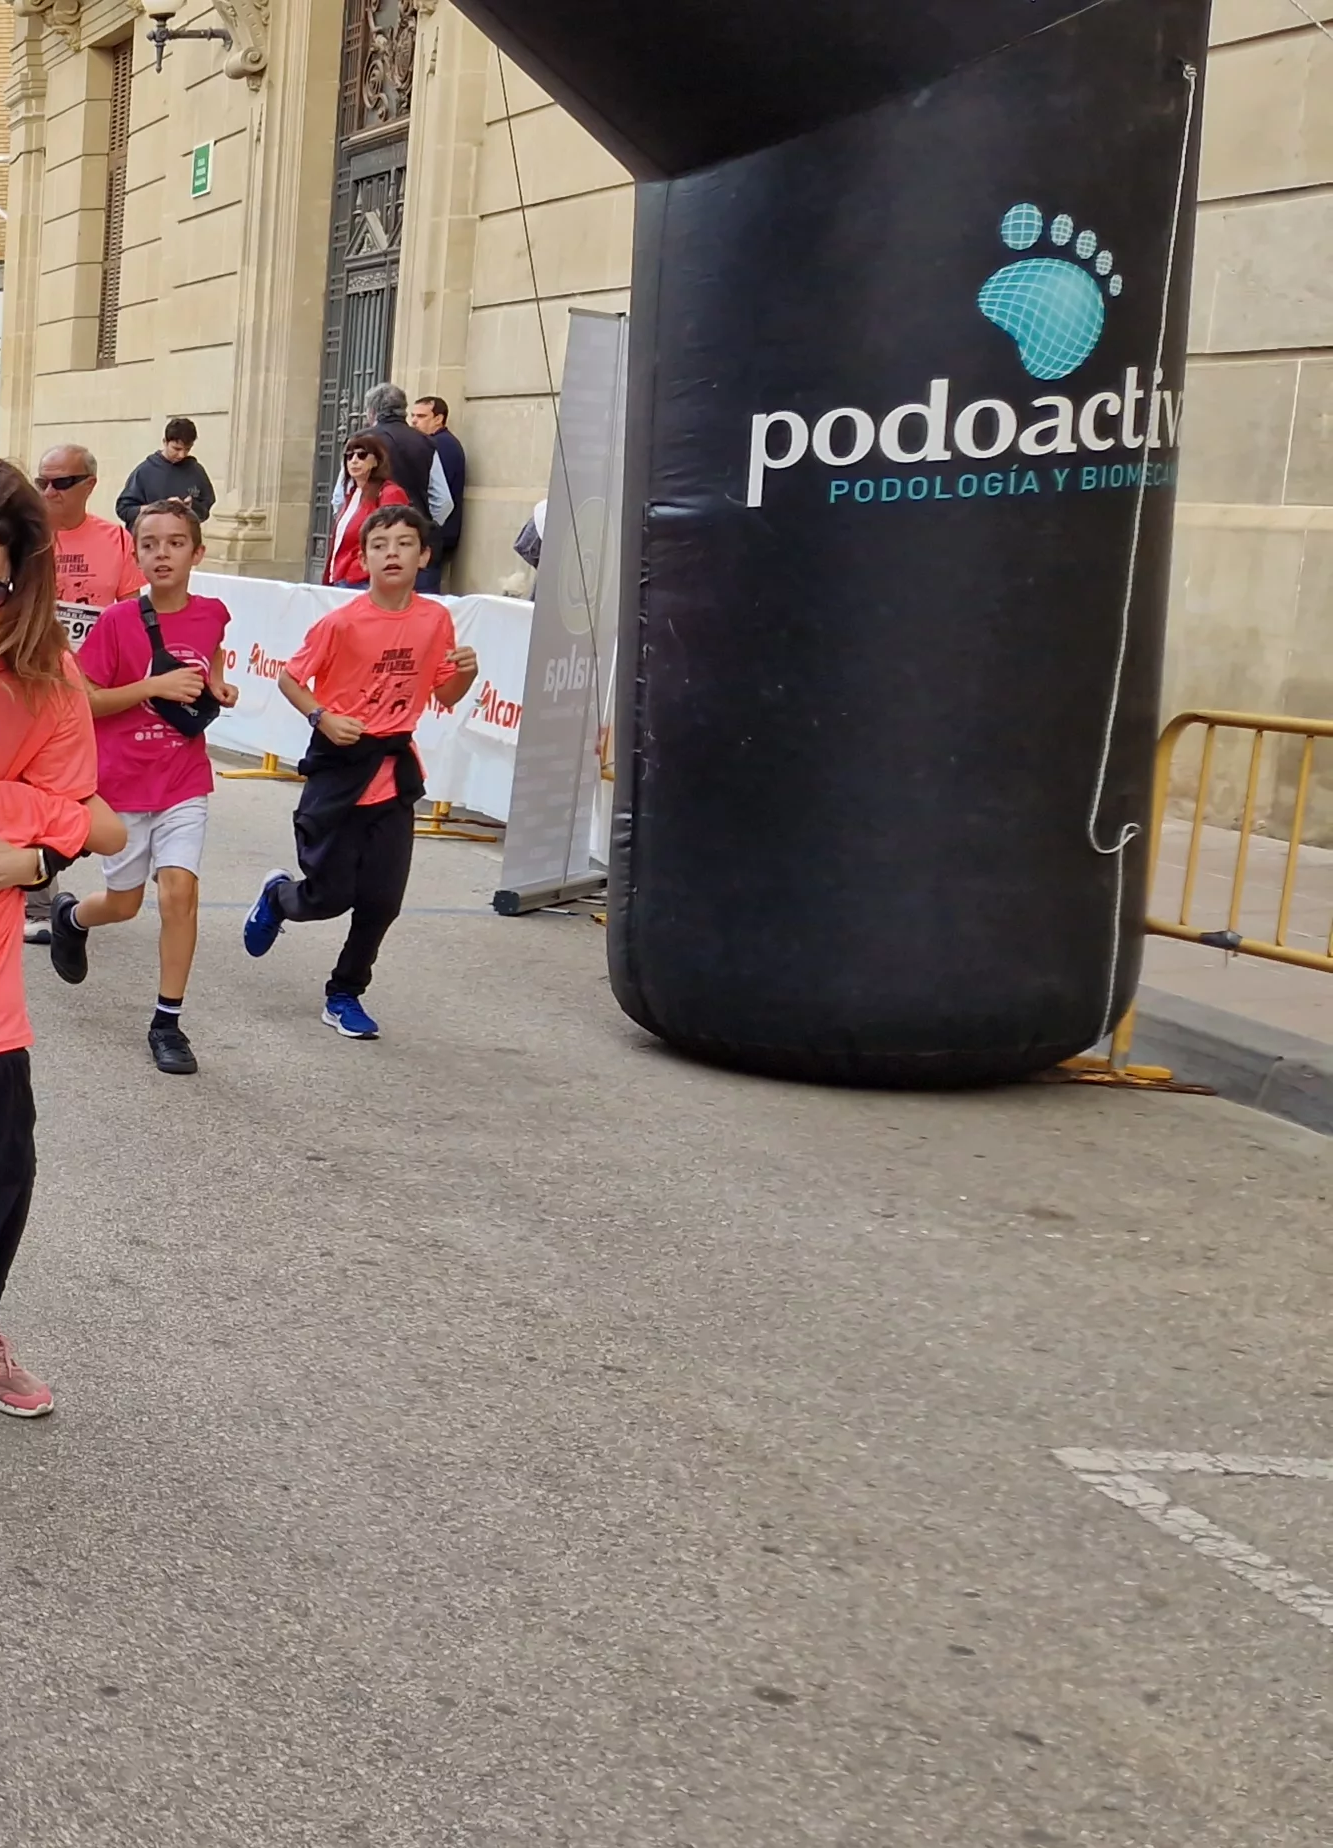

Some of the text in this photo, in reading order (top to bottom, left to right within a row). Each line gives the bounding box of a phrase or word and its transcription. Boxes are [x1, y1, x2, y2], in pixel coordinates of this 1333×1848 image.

[746, 366, 1183, 508] podoactiv
[829, 464, 1040, 503] PODOLOGÍA
[1053, 468, 1071, 491] Y
